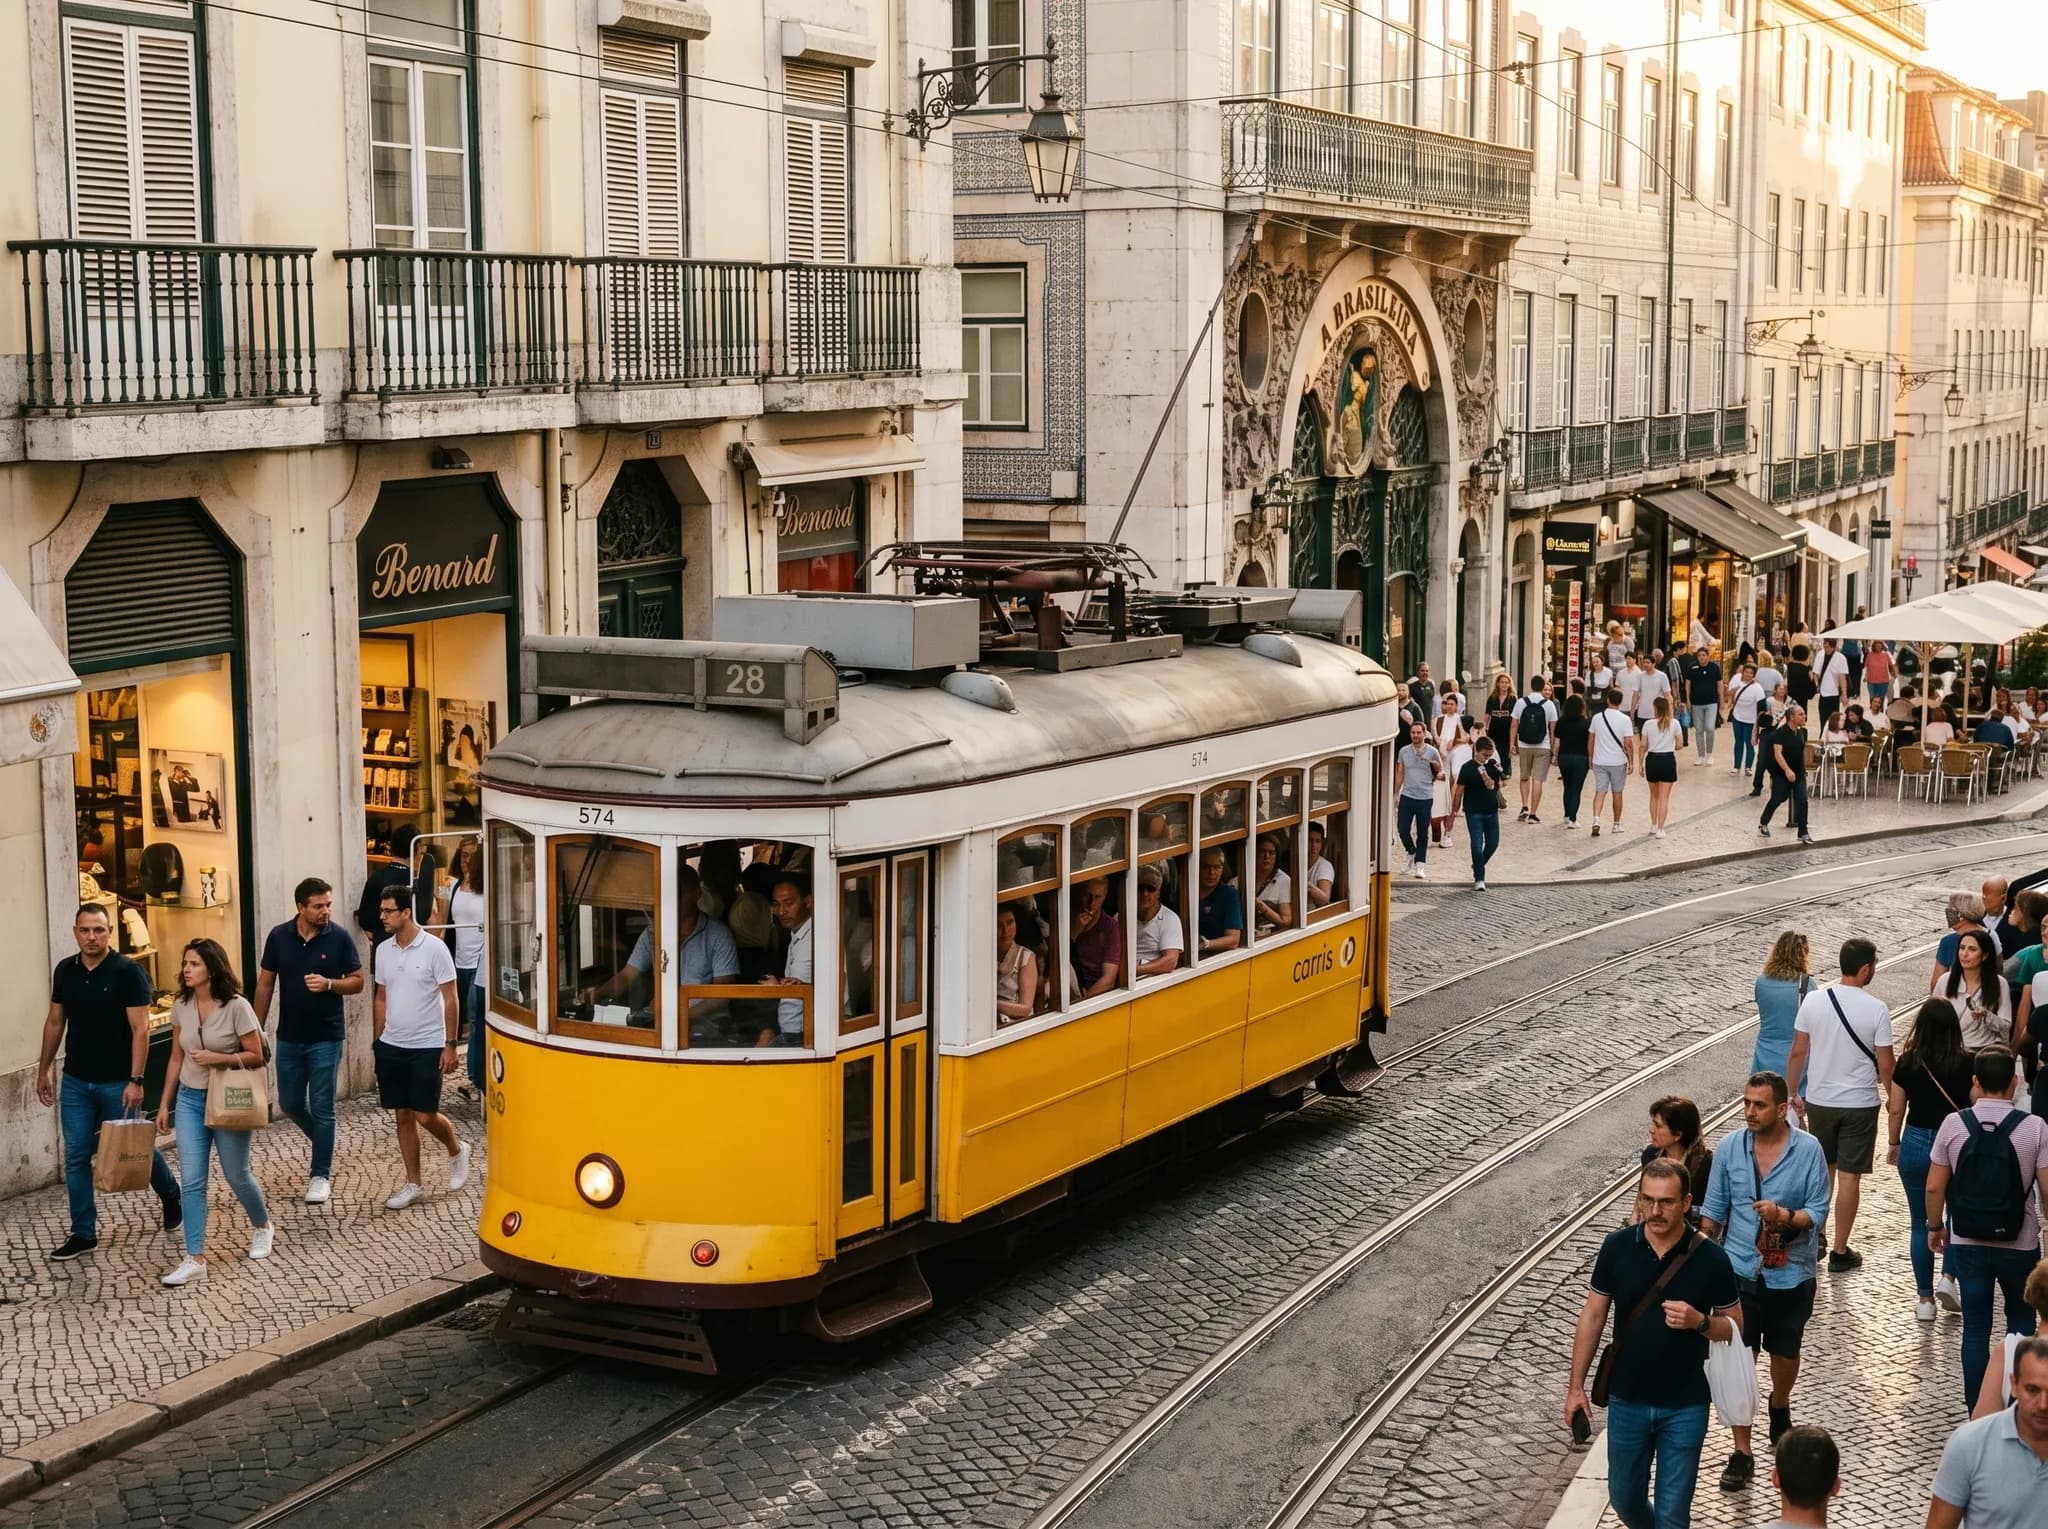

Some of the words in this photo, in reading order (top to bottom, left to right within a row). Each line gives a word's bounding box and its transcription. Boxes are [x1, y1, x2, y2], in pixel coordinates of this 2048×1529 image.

[1321, 323, 1333, 352] A
[1333, 284, 1418, 356] BRASILEIRA
[778, 489, 856, 537] Benard
[371, 533, 499, 599] Benard
[726, 663, 765, 695] 28
[1191, 751, 1208, 767] 574
[578, 806, 615, 826] 574
[1293, 943, 1333, 984] carris
